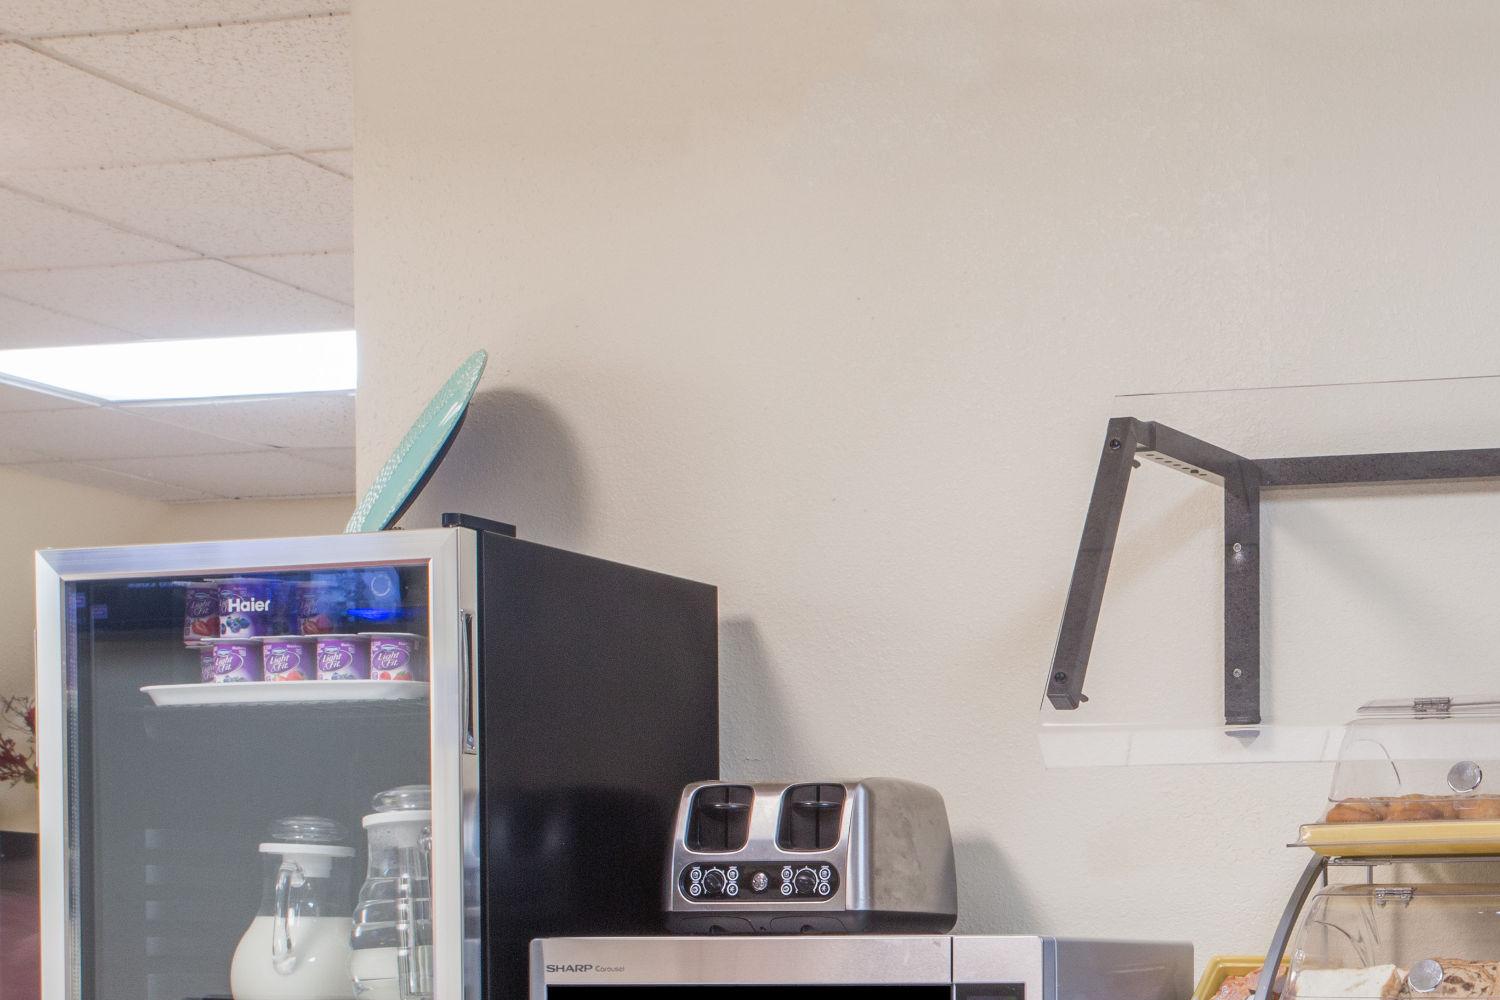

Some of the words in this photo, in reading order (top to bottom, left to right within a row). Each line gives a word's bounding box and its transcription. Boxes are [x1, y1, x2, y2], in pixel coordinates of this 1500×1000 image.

[228, 597, 271, 613] Haier
[270, 654, 290, 666] Light
[322, 653, 342, 665] Light
[377, 652, 400, 665] Light
[546, 964, 593, 973] SHARP
